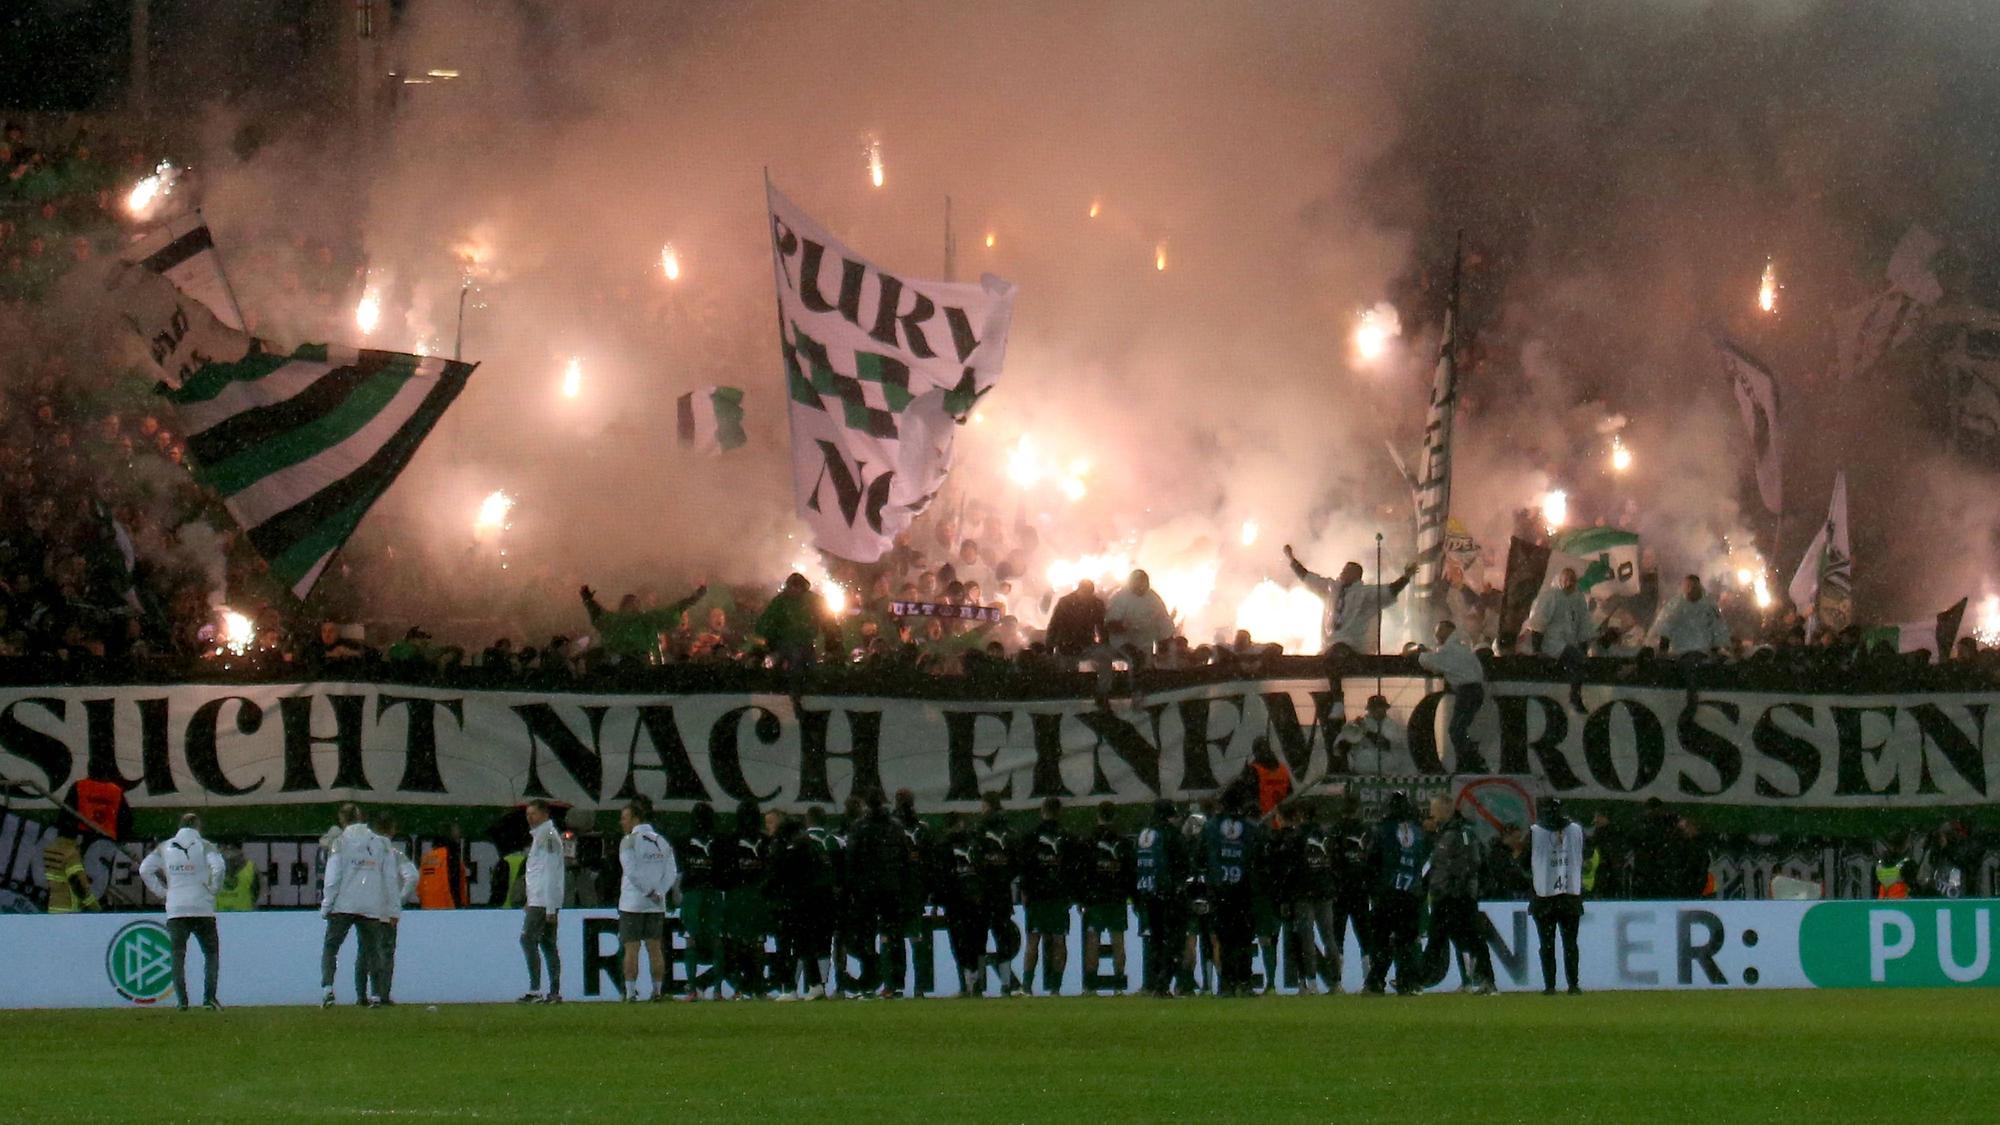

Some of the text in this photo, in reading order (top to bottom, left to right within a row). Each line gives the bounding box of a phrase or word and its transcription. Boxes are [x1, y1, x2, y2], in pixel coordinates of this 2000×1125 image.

[0, 695, 464, 799] SUCHT
[511, 702, 885, 802] NACH
[942, 690, 1351, 801] EINEM
[1394, 909, 1759, 989] UNER:
[1869, 907, 1991, 983] PU
